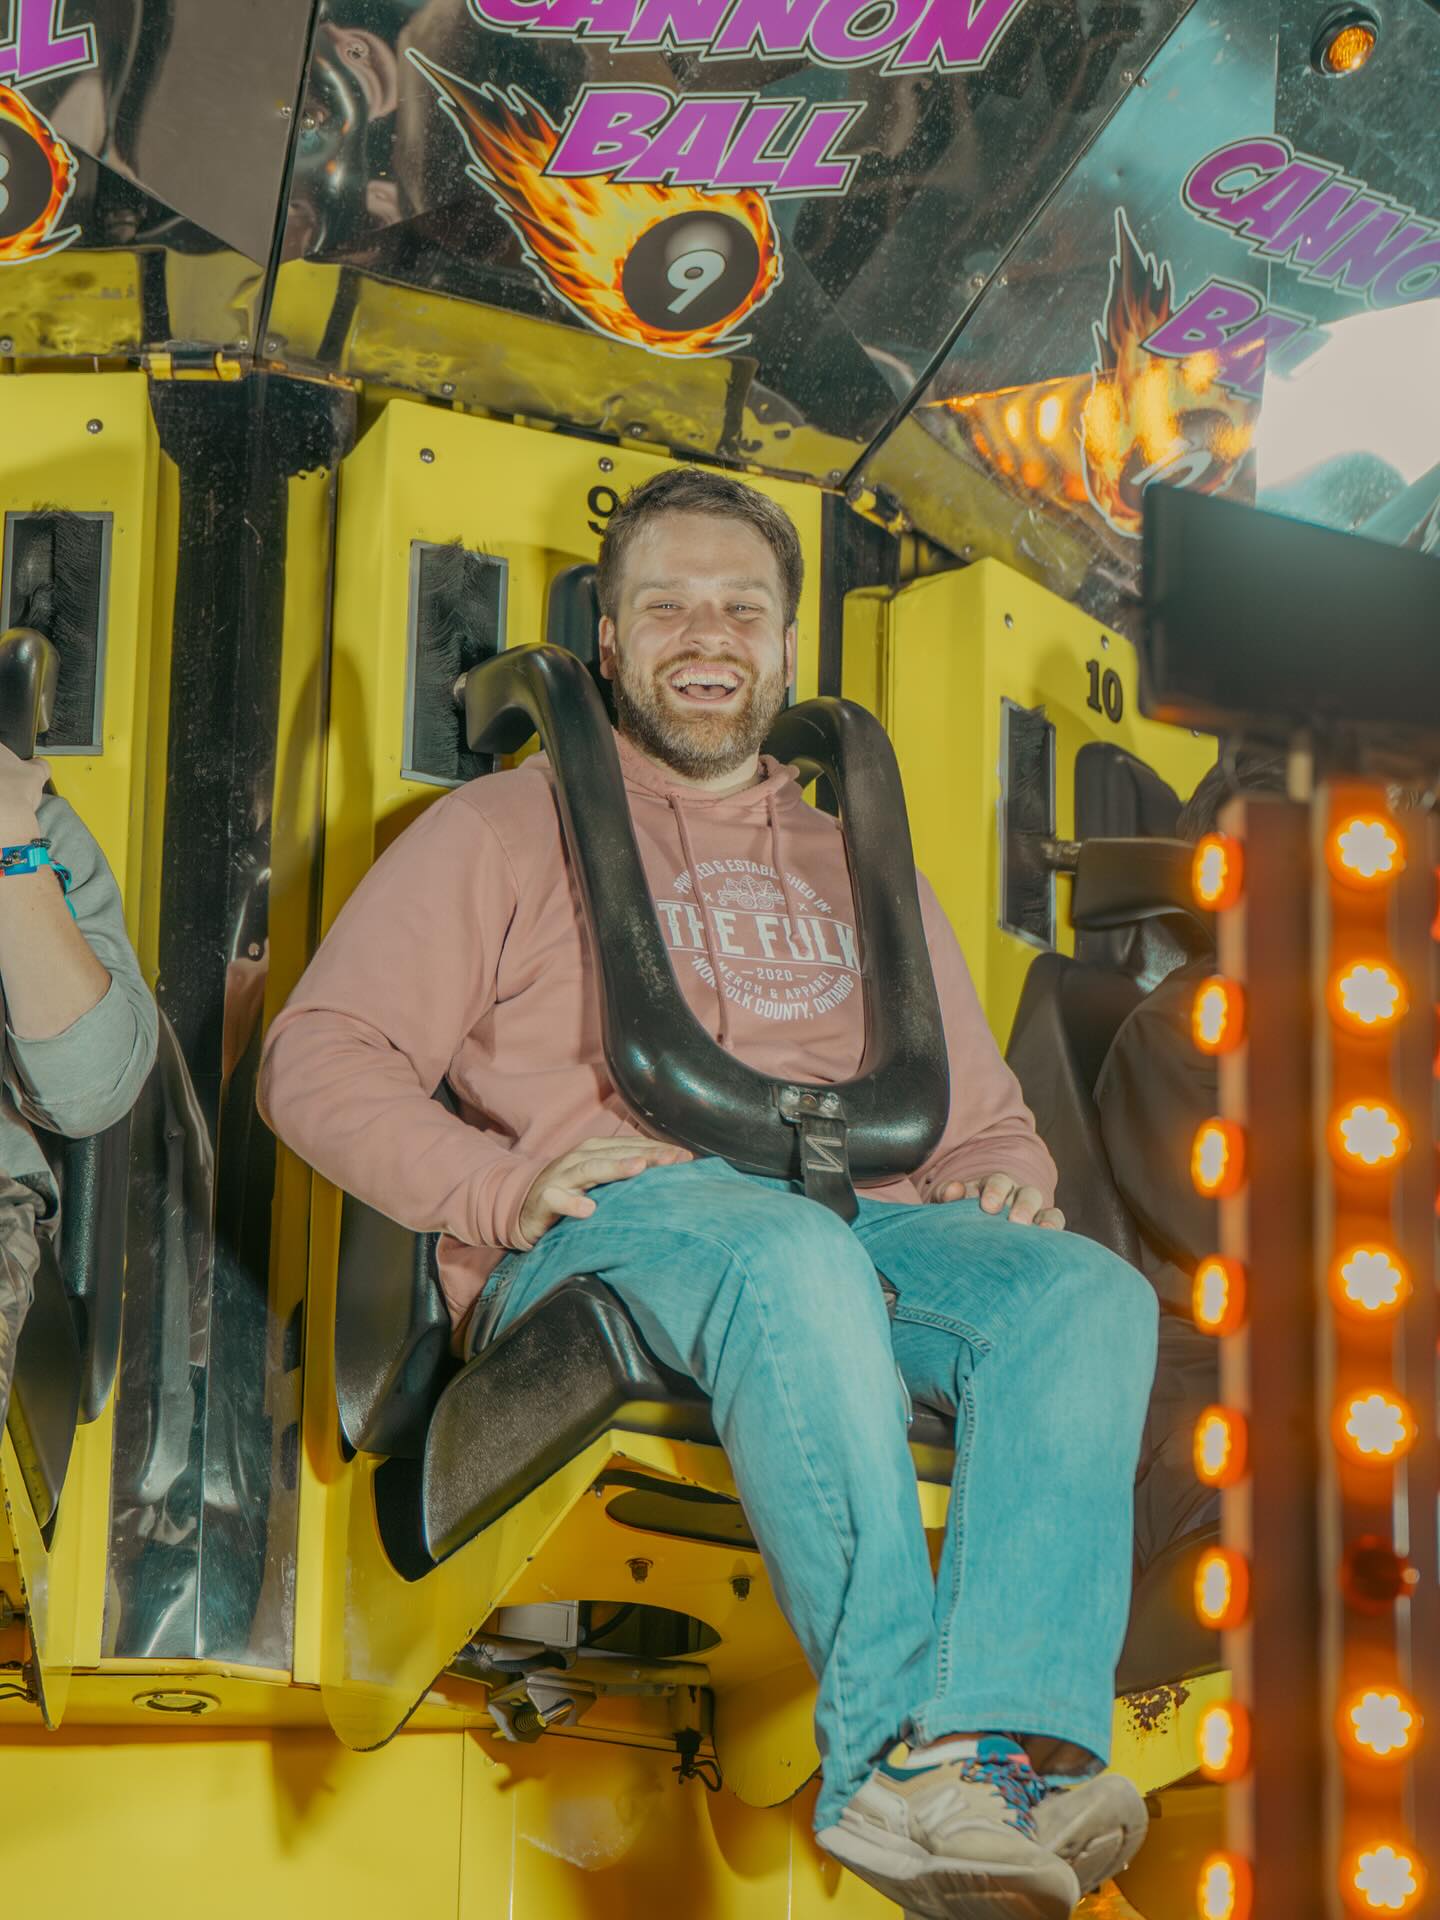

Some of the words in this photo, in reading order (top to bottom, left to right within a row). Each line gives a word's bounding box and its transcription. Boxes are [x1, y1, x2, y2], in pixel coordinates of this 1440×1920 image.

[543, 83, 867, 198] BALL
[666, 249, 726, 314] 9
[587, 485, 620, 537] 9
[1086, 659, 1123, 724] 10
[673, 861, 716, 895] PRIED
[712, 860, 728, 873] &
[725, 859, 817, 900] ESTABLHED
[656, 902, 745, 956] THE
[691, 956, 753, 1009] NOROLK
[754, 998, 814, 1021] COUNTY,
[756, 967, 793, 982] 2020
[769, 987, 779, 1000] &
[783, 970, 835, 1001] APPAREL
